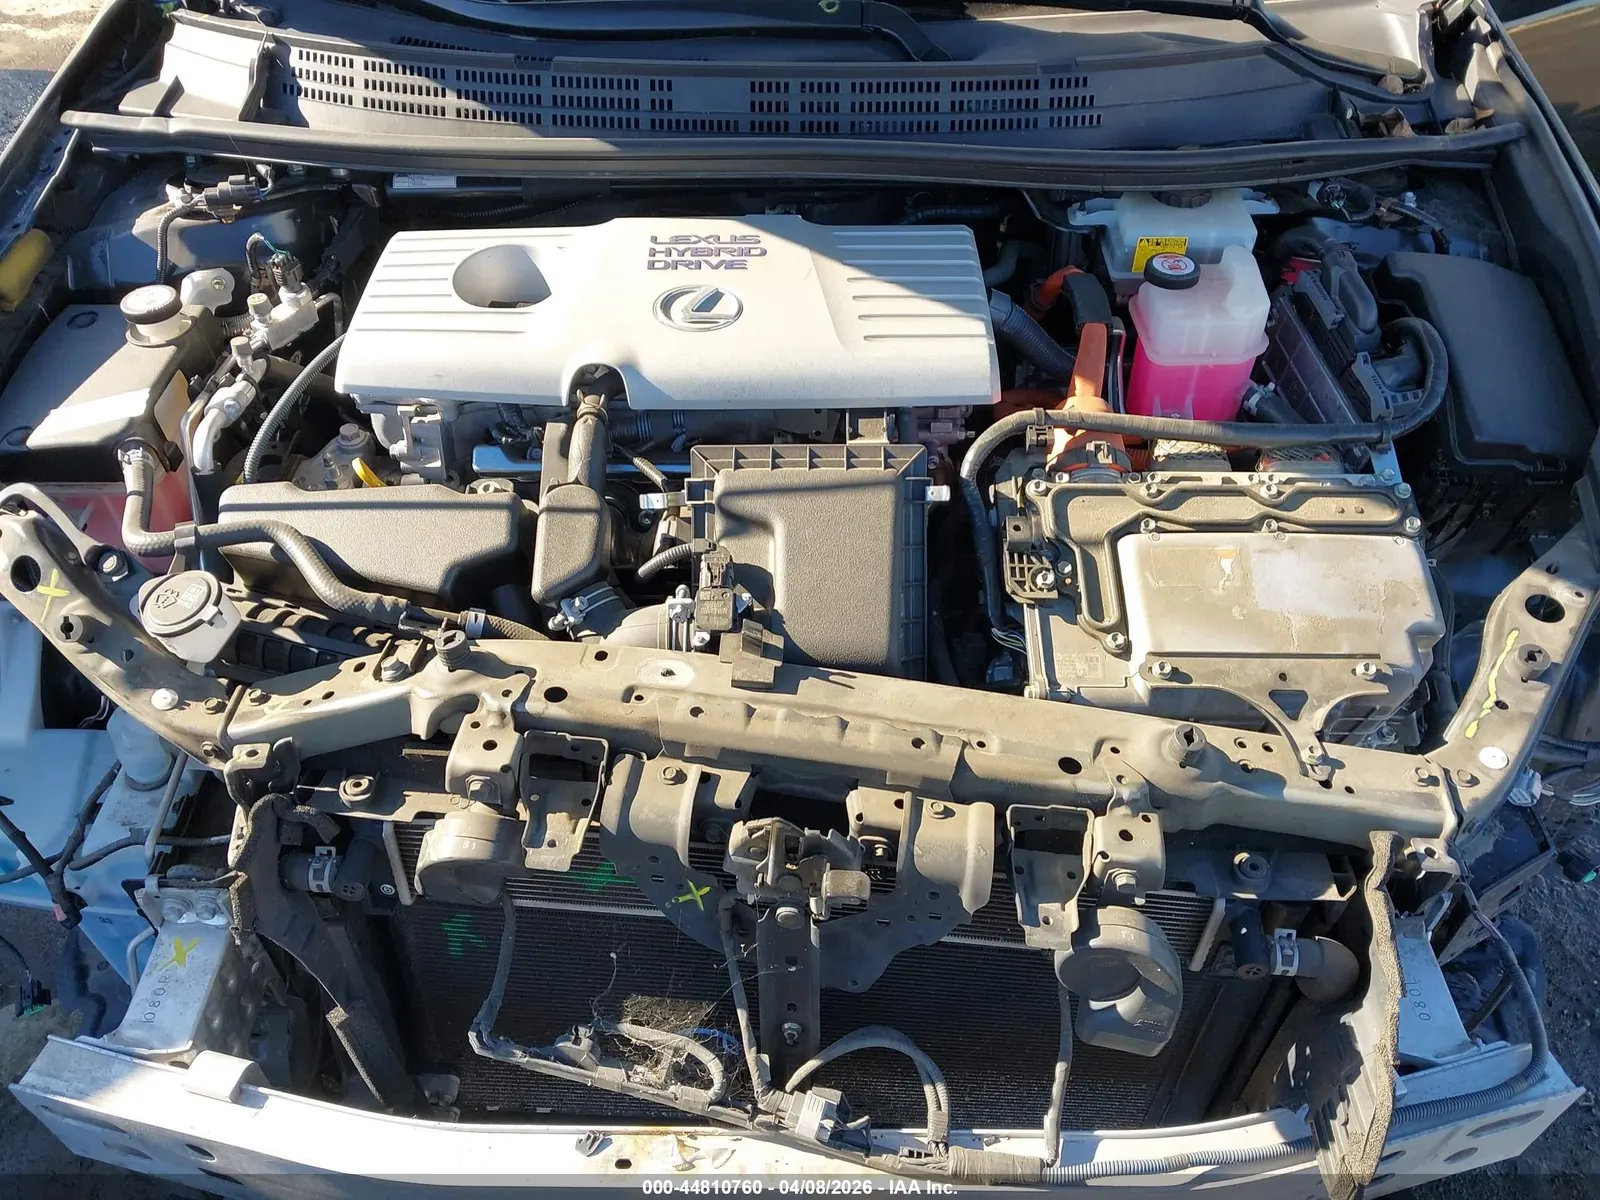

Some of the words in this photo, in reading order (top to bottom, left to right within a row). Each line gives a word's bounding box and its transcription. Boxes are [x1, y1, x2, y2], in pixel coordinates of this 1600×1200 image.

[650, 234, 761, 245] LEXUS
[648, 246, 767, 258] HYBRID
[646, 259, 748, 271] DRIVE
